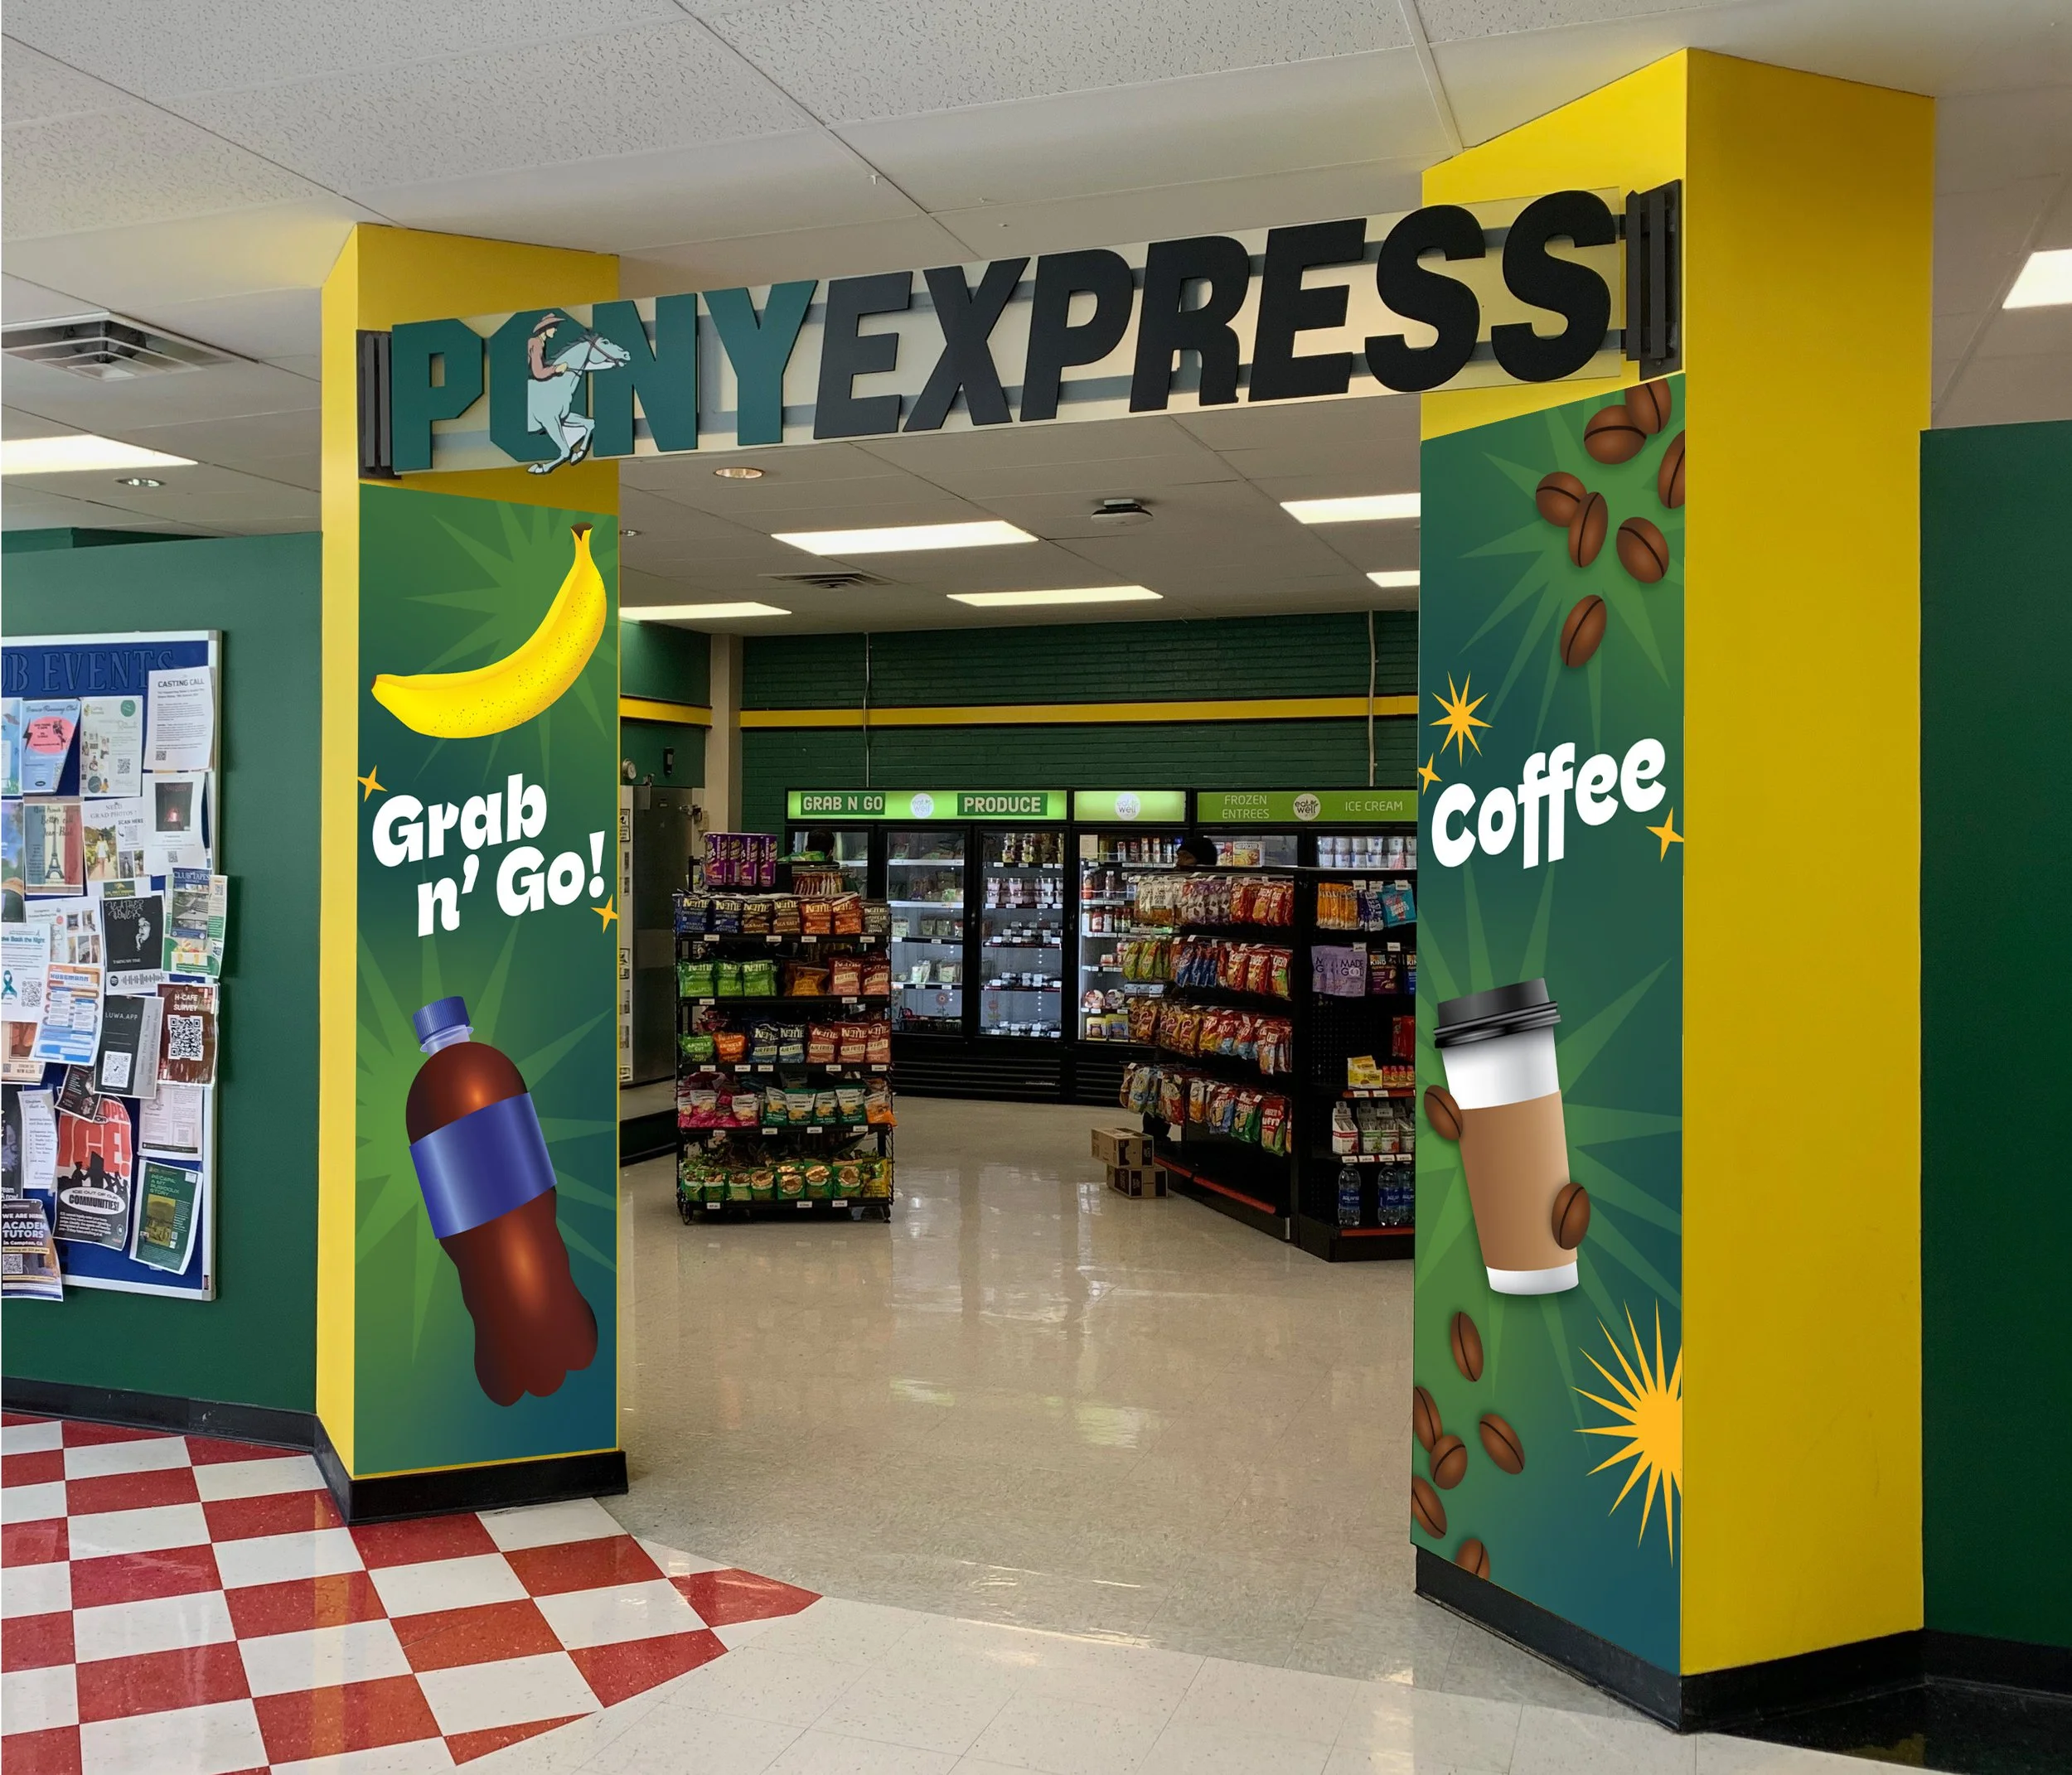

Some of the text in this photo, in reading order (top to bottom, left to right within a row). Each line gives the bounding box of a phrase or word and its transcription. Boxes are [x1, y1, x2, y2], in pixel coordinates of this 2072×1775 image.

[157, 678, 205, 688] CASTING CALL
[803, 796, 883, 811] GRAB N GO
[963, 796, 1041, 813] PRODUCE
[1224, 795, 1267, 805] FROZEN
[1431, 738, 1666, 869] Coffee
[1119, 804, 1136, 814] well
[1297, 805, 1316, 814] well
[1345, 800, 1403, 812] ICE CREAM
[1222, 809, 1269, 819] ENTREES
[372, 772, 547, 867] Grab
[496, 830, 605, 917] Go!
[1340, 959, 1363, 968] MADE
[1340, 967, 1364, 977] GOOD
[149, 1187, 169, 1196] STORY
[69, 1194, 119, 1212] COMMUNITIES!
[2, 1230, 44, 1239] TUTORS
